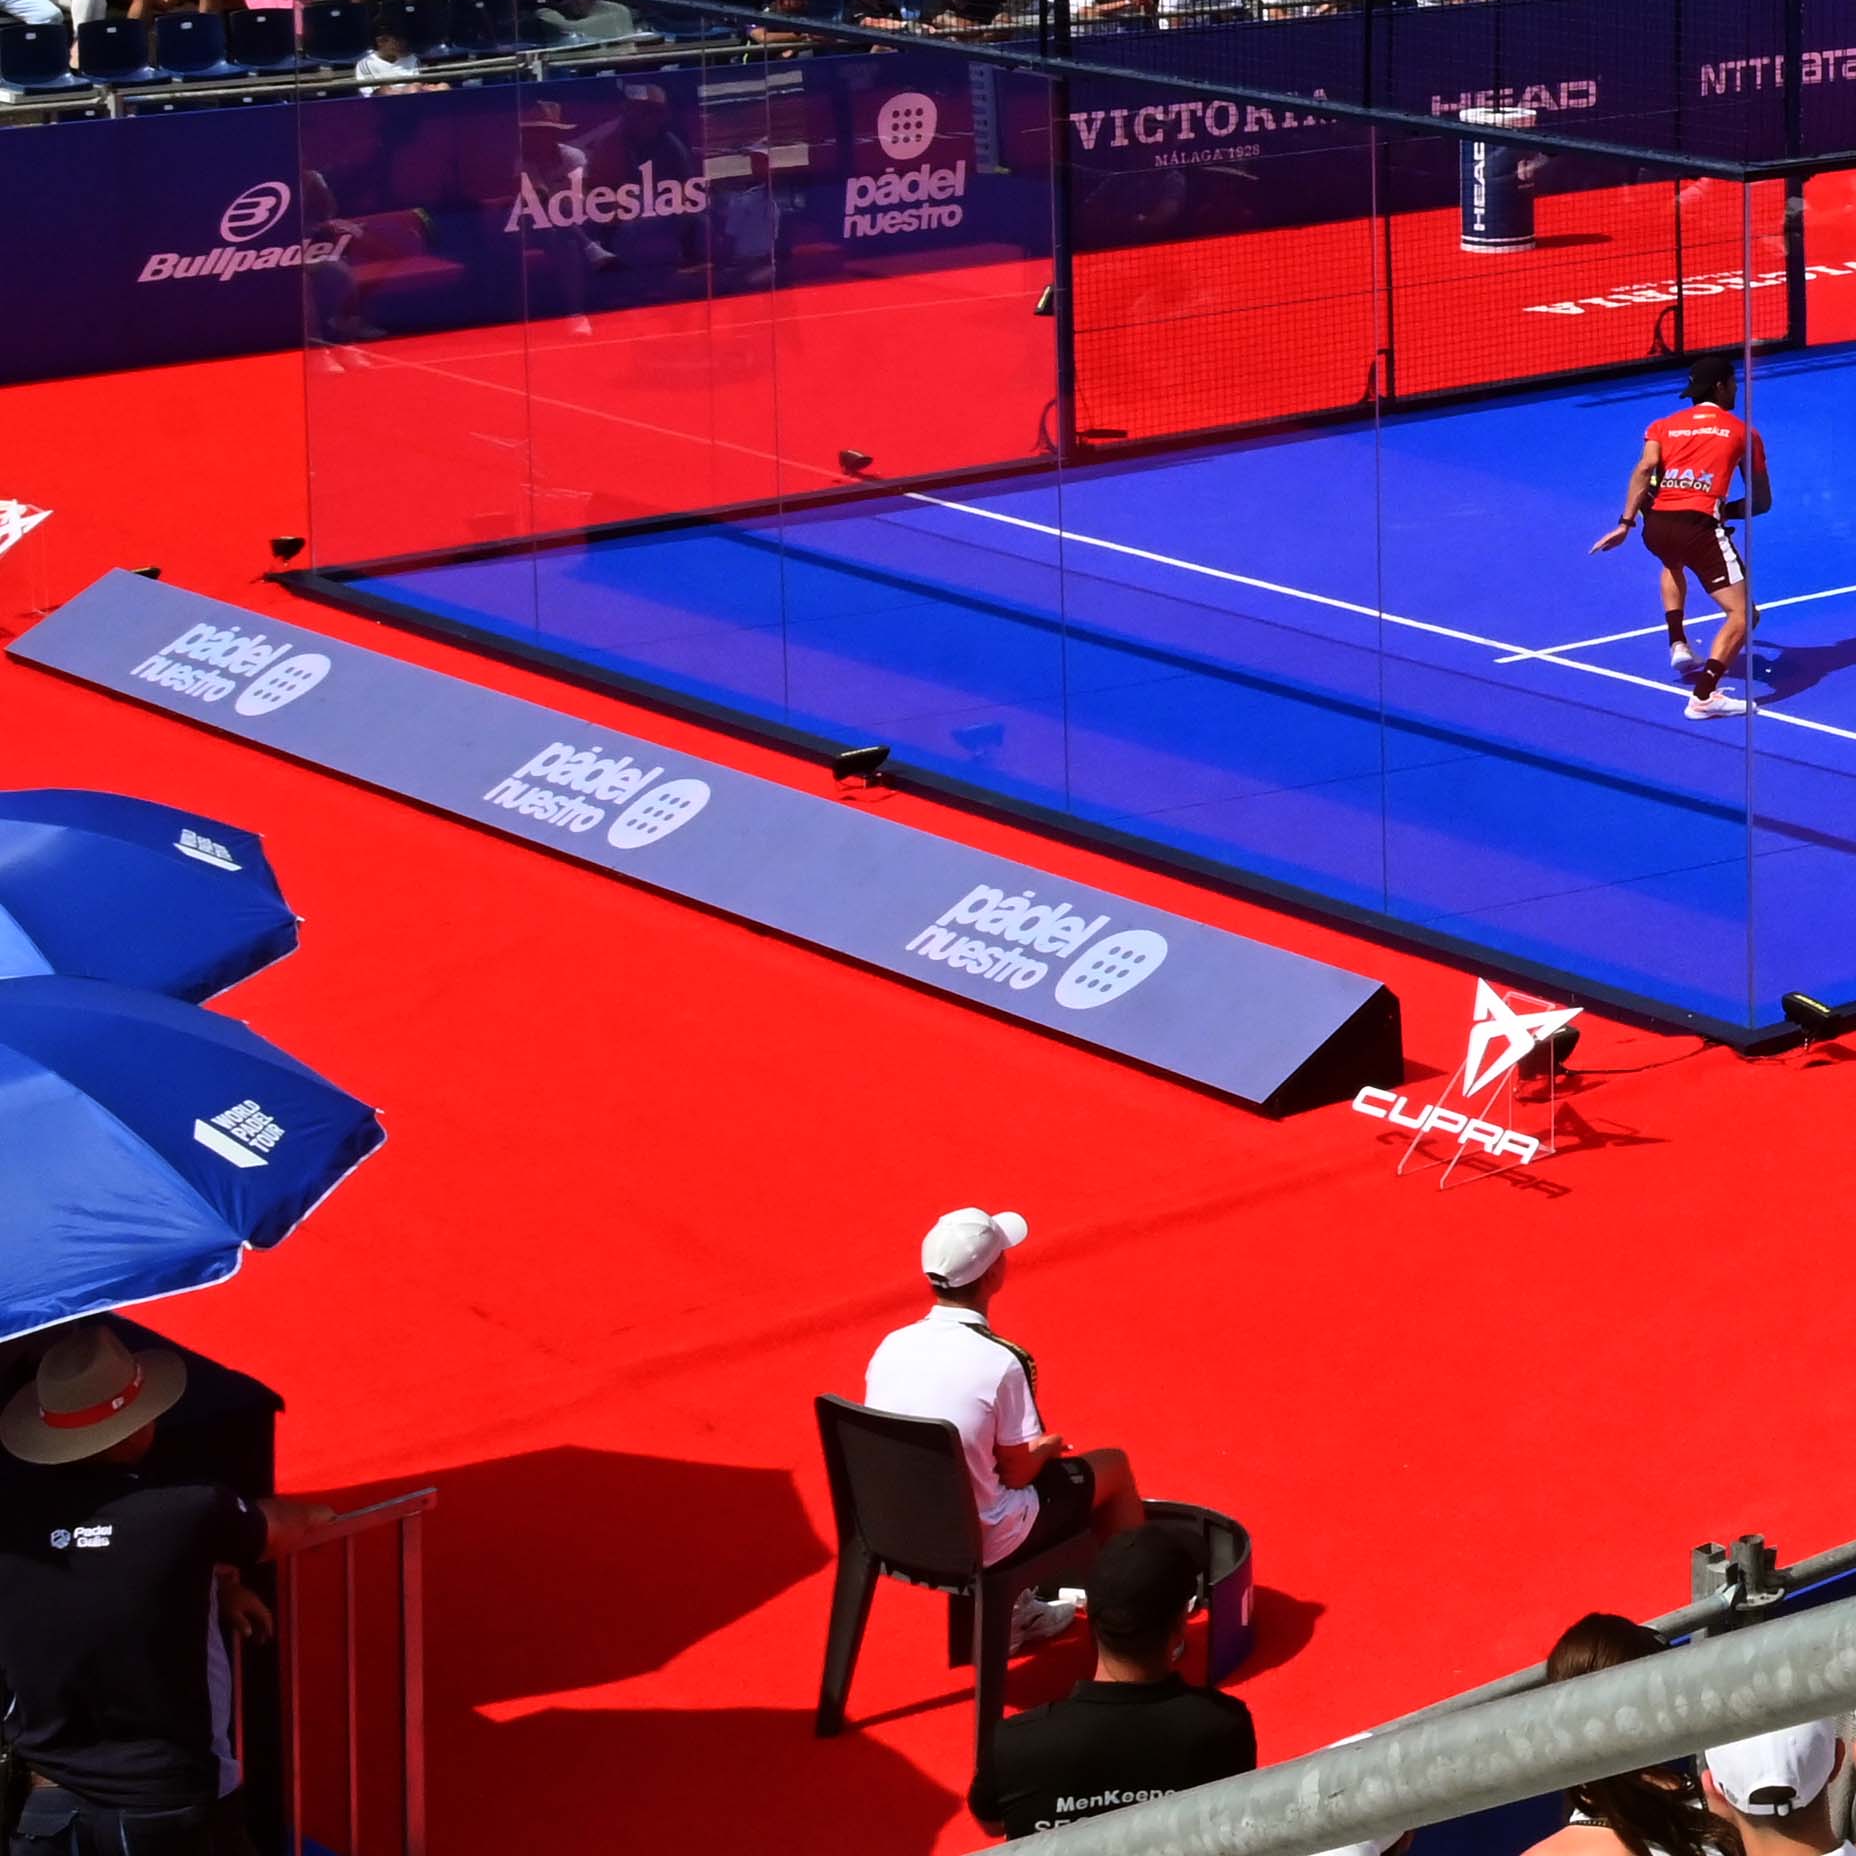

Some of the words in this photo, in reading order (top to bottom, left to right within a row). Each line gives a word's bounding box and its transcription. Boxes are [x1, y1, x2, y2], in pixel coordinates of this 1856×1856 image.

[1702, 55, 1771, 97] NTT
[1155, 147, 1222, 170] MÁLAGA
[1227, 143, 1262, 161] 1928
[505, 161, 706, 234] Adeslas
[843, 159, 967, 210] pádel
[842, 197, 963, 240] nuestro
[137, 233, 351, 282] Bullpadel
[172, 623, 288, 680] pádel
[130, 653, 237, 703] nuestro
[533, 741, 663, 808] pádel
[484, 780, 606, 833] nuestro
[945, 882, 1107, 962] pádel
[906, 924, 1043, 991] nuestro
[210, 1098, 261, 1130] WORLD
[230, 1111, 275, 1143] PADEL
[249, 1123, 286, 1153] TOUR
[1352, 1085, 1540, 1164] CUPRA
[73, 1524, 113, 1539] Padel
